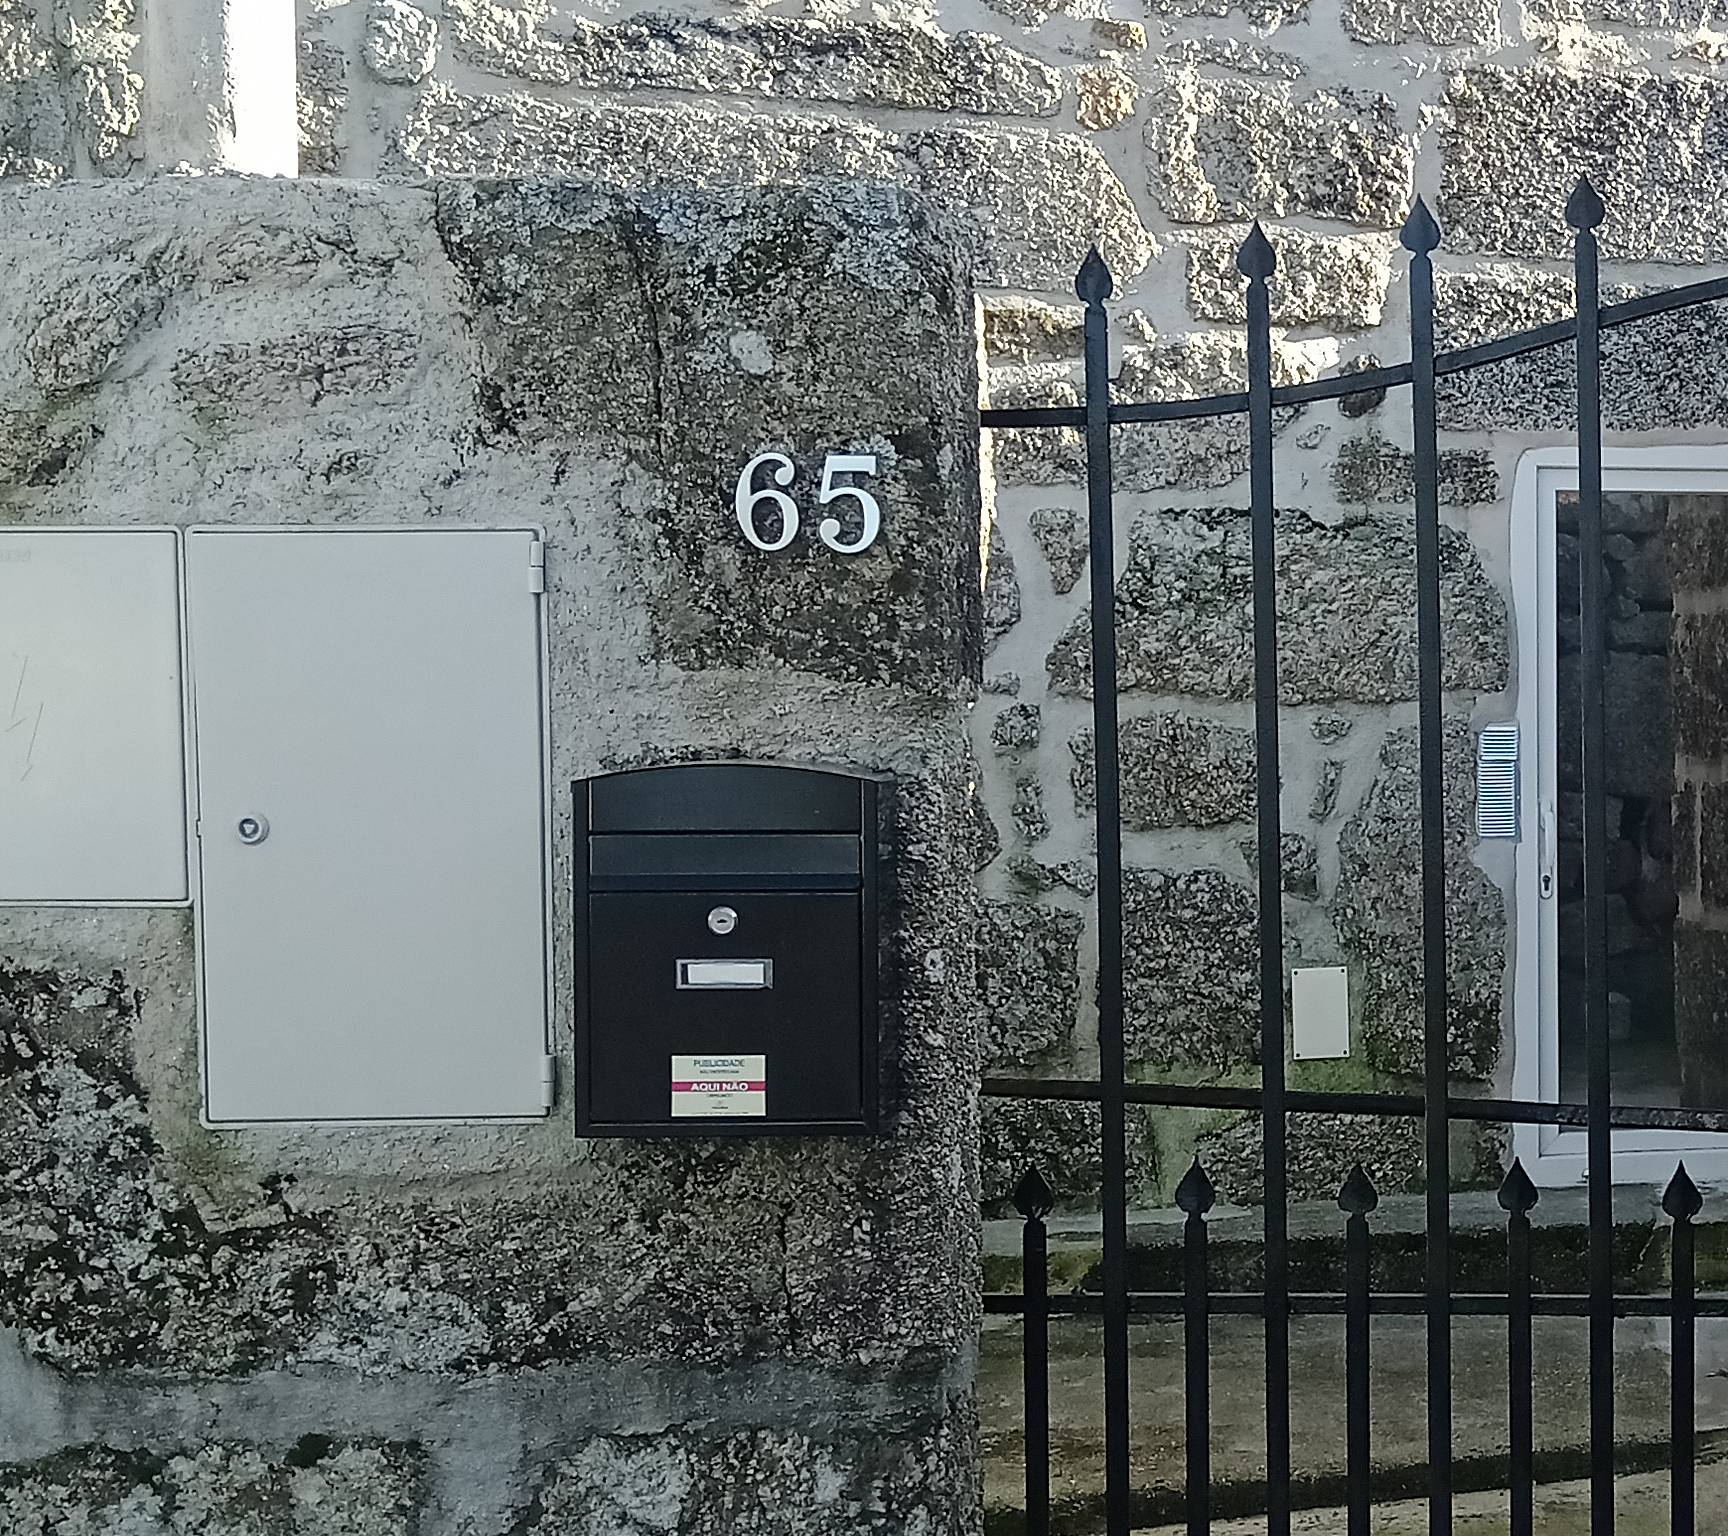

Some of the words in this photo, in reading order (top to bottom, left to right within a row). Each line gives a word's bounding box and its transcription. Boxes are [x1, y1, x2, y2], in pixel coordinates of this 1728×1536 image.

[735, 452, 880, 554] 65
[693, 1059, 746, 1068] PUBLICIDADE
[690, 1082, 720, 1092] AQUI
[722, 1080, 749, 1092] NÃO
